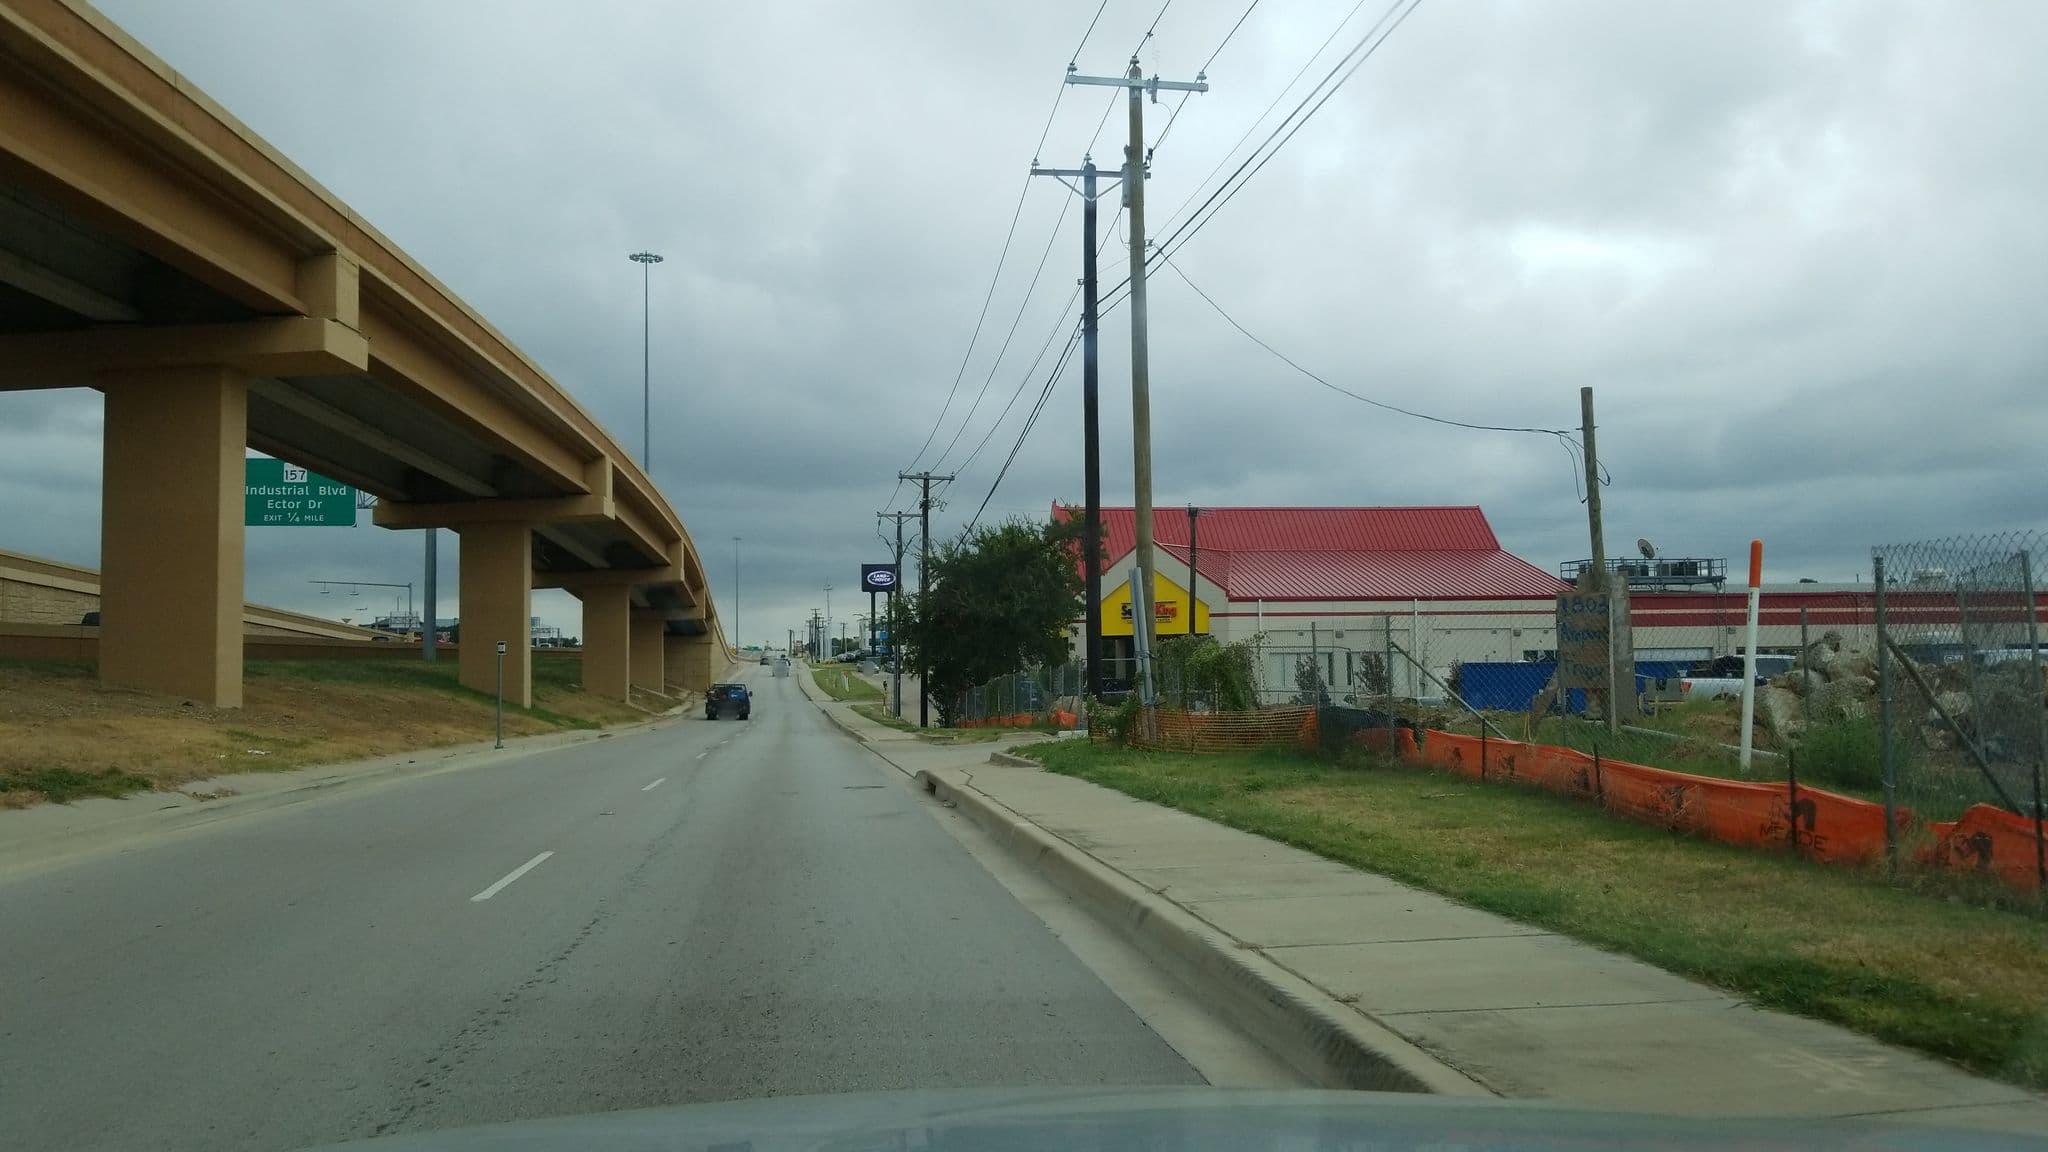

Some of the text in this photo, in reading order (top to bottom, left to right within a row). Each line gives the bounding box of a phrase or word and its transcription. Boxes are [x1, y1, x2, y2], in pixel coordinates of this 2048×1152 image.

[285, 470, 306, 481] 157
[245, 485, 347, 496] Industrial Blvd
[267, 499, 323, 509] Ector Dr
[263, 514, 282, 522] EXIT
[304, 514, 325, 522] MILE
